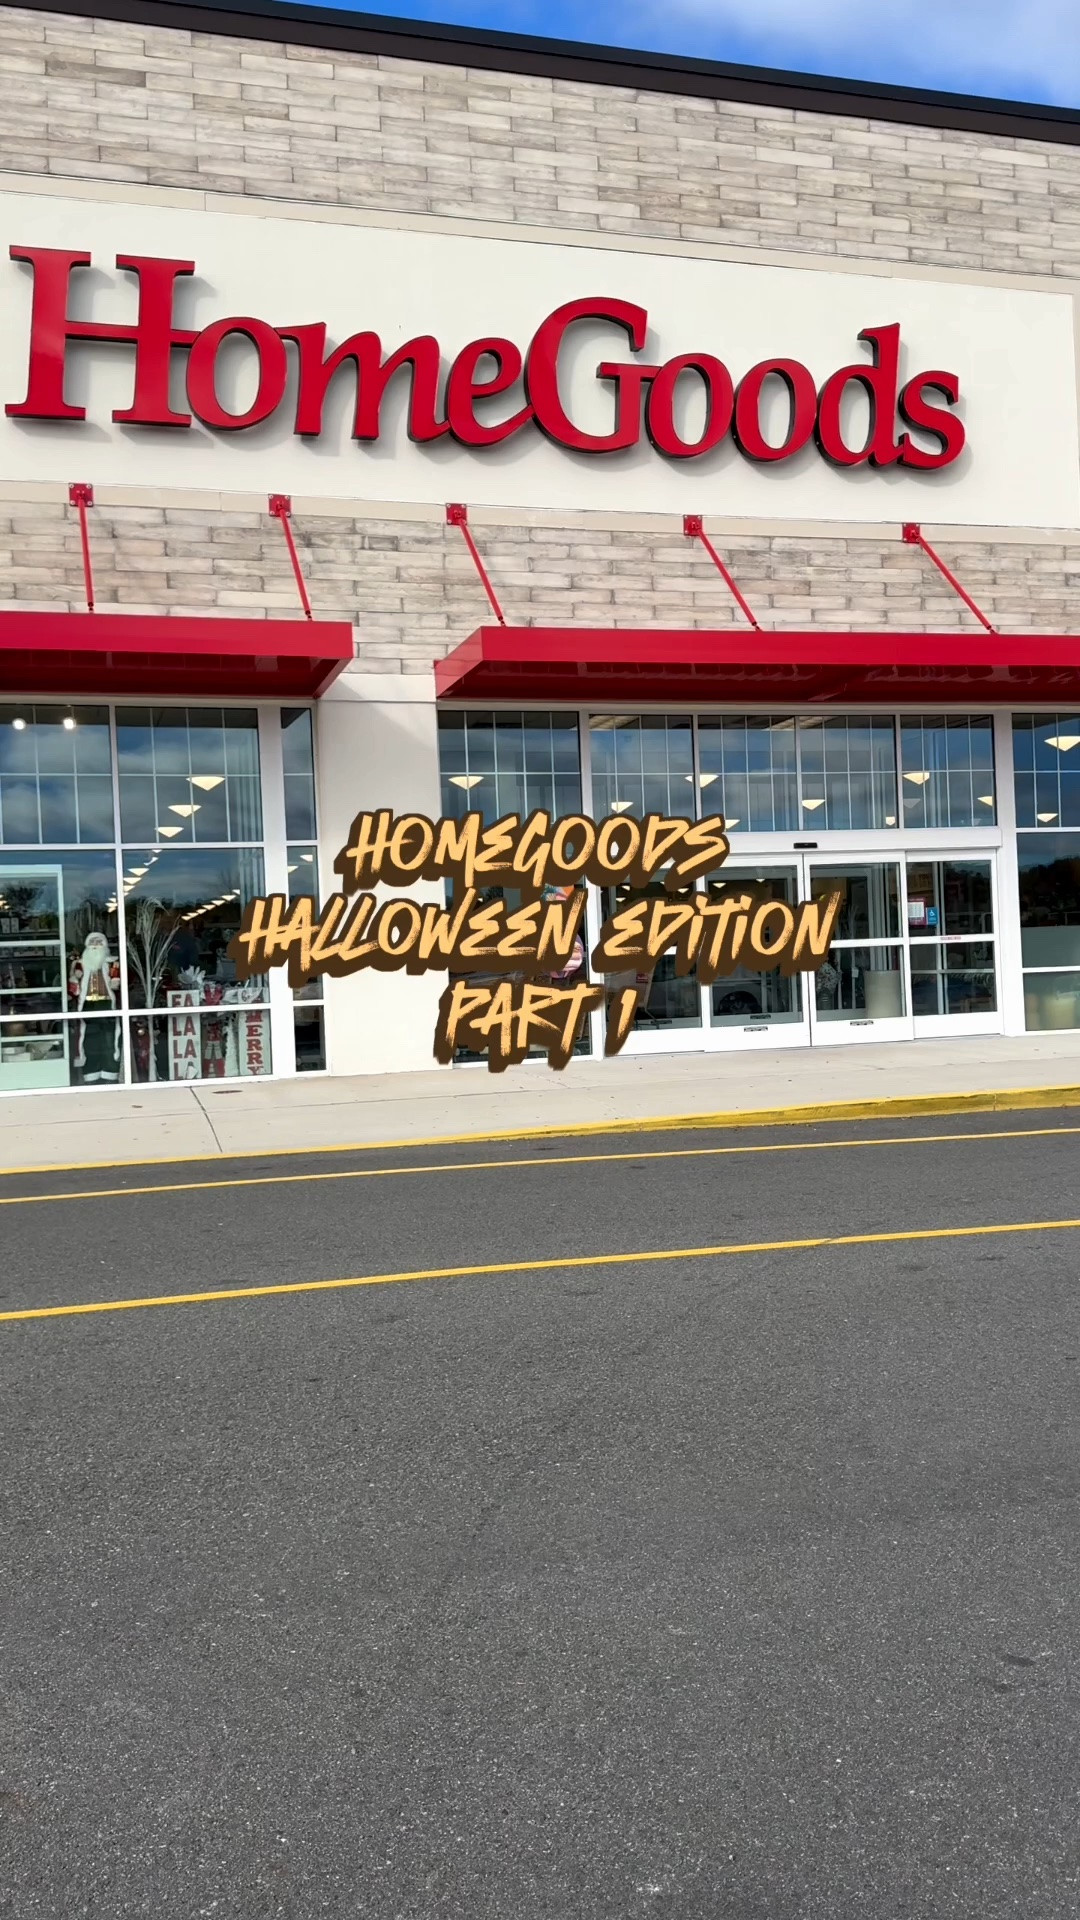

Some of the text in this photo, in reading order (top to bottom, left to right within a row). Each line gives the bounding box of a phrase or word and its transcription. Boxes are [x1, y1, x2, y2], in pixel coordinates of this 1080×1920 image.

[6, 246, 966, 470] HomeGoods
[172, 1016, 196, 1036] LA
[173, 1039, 197, 1059] LA
